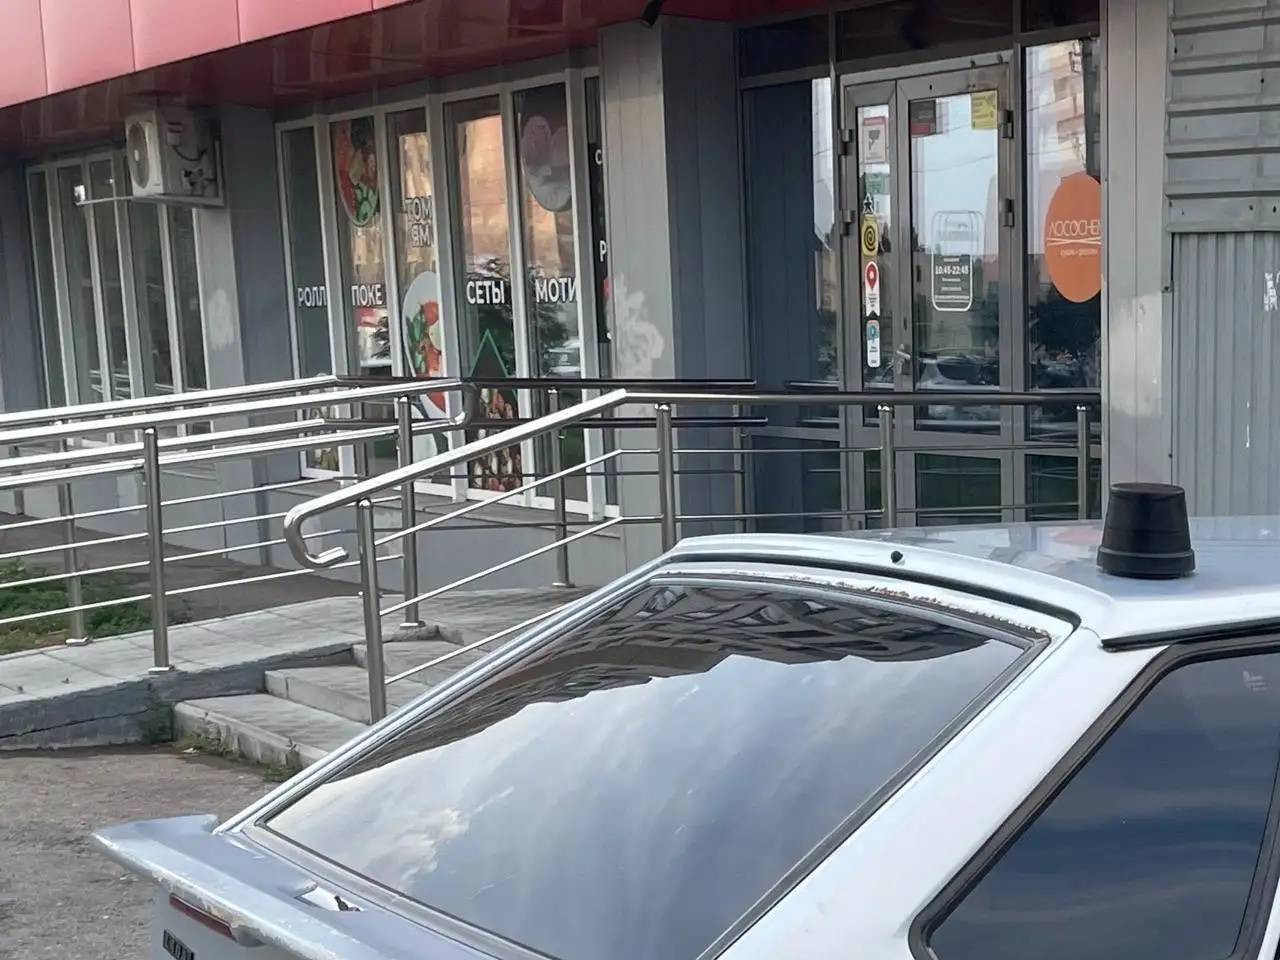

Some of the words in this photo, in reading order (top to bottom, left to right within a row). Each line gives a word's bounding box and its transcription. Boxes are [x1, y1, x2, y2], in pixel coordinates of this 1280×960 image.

[405, 196, 432, 222] ТОМ
[411, 222, 433, 248] ЯМ
[351, 284, 383, 306] ПОКЕ
[466, 280, 505, 304] СЕТЫ
[535, 278, 577, 303] МОТИ
